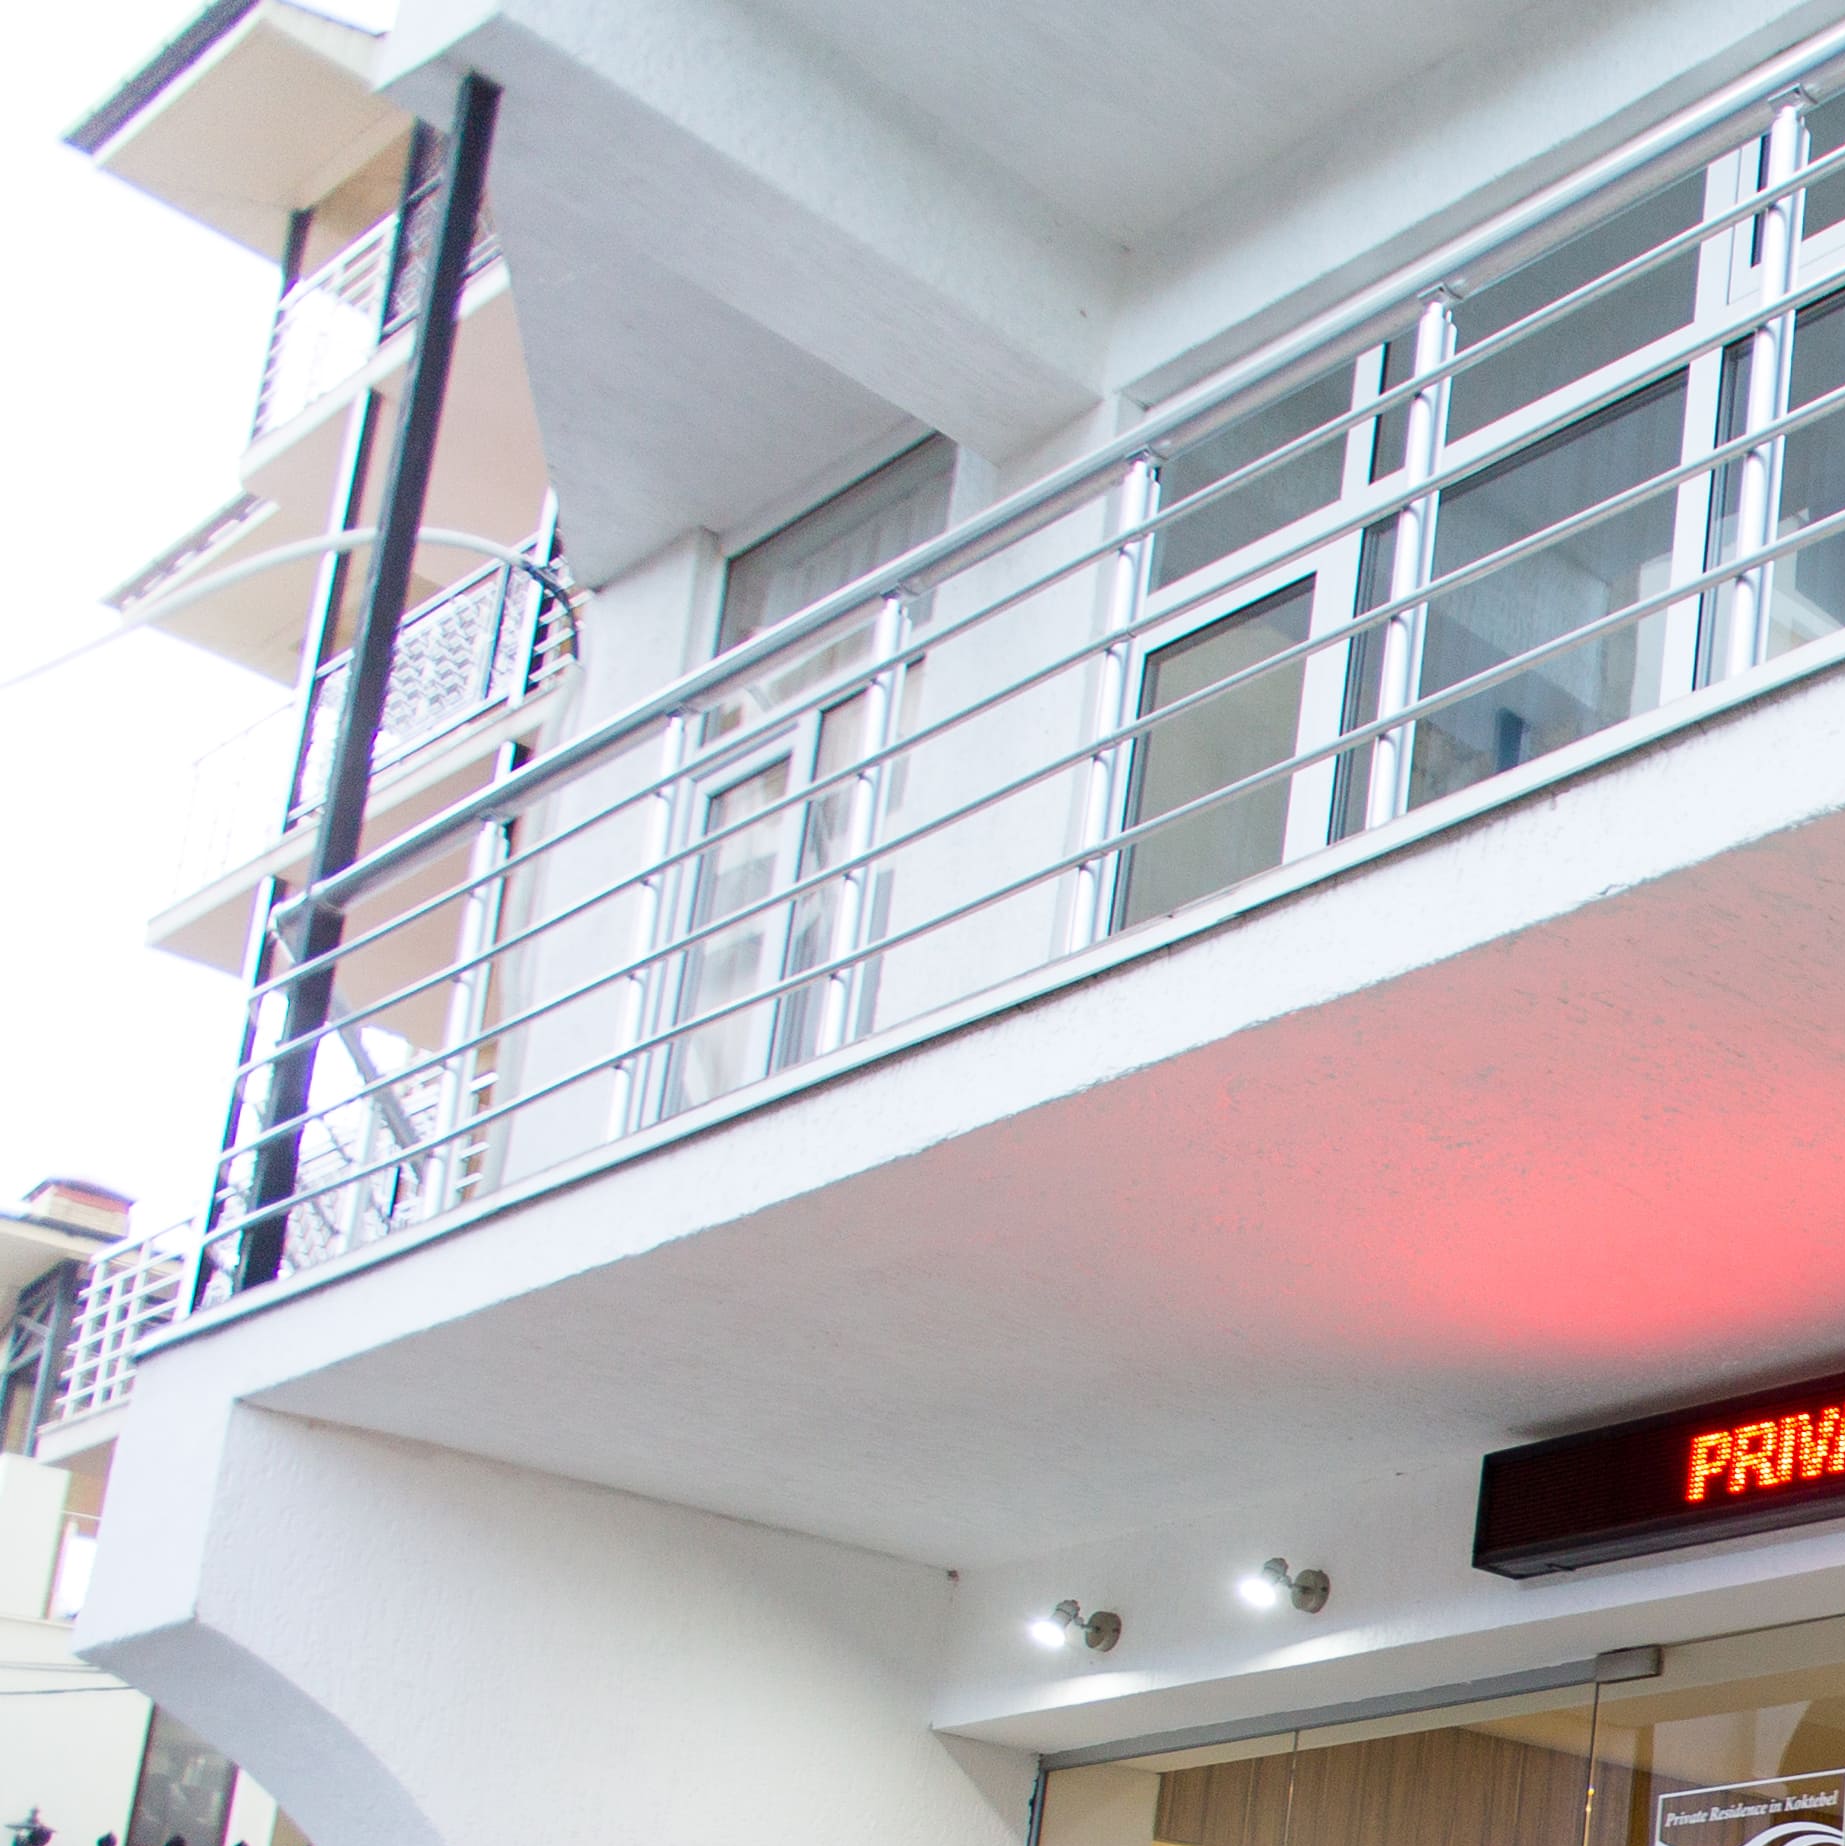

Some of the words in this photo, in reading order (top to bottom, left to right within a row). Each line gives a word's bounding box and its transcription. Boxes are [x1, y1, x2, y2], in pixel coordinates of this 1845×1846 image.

[1664, 1810, 1709, 1828] Private
[1709, 1802, 1768, 1822] Residence
[1768, 1798, 1784, 1813] in
[1784, 1789, 1840, 1811] Koktebel
